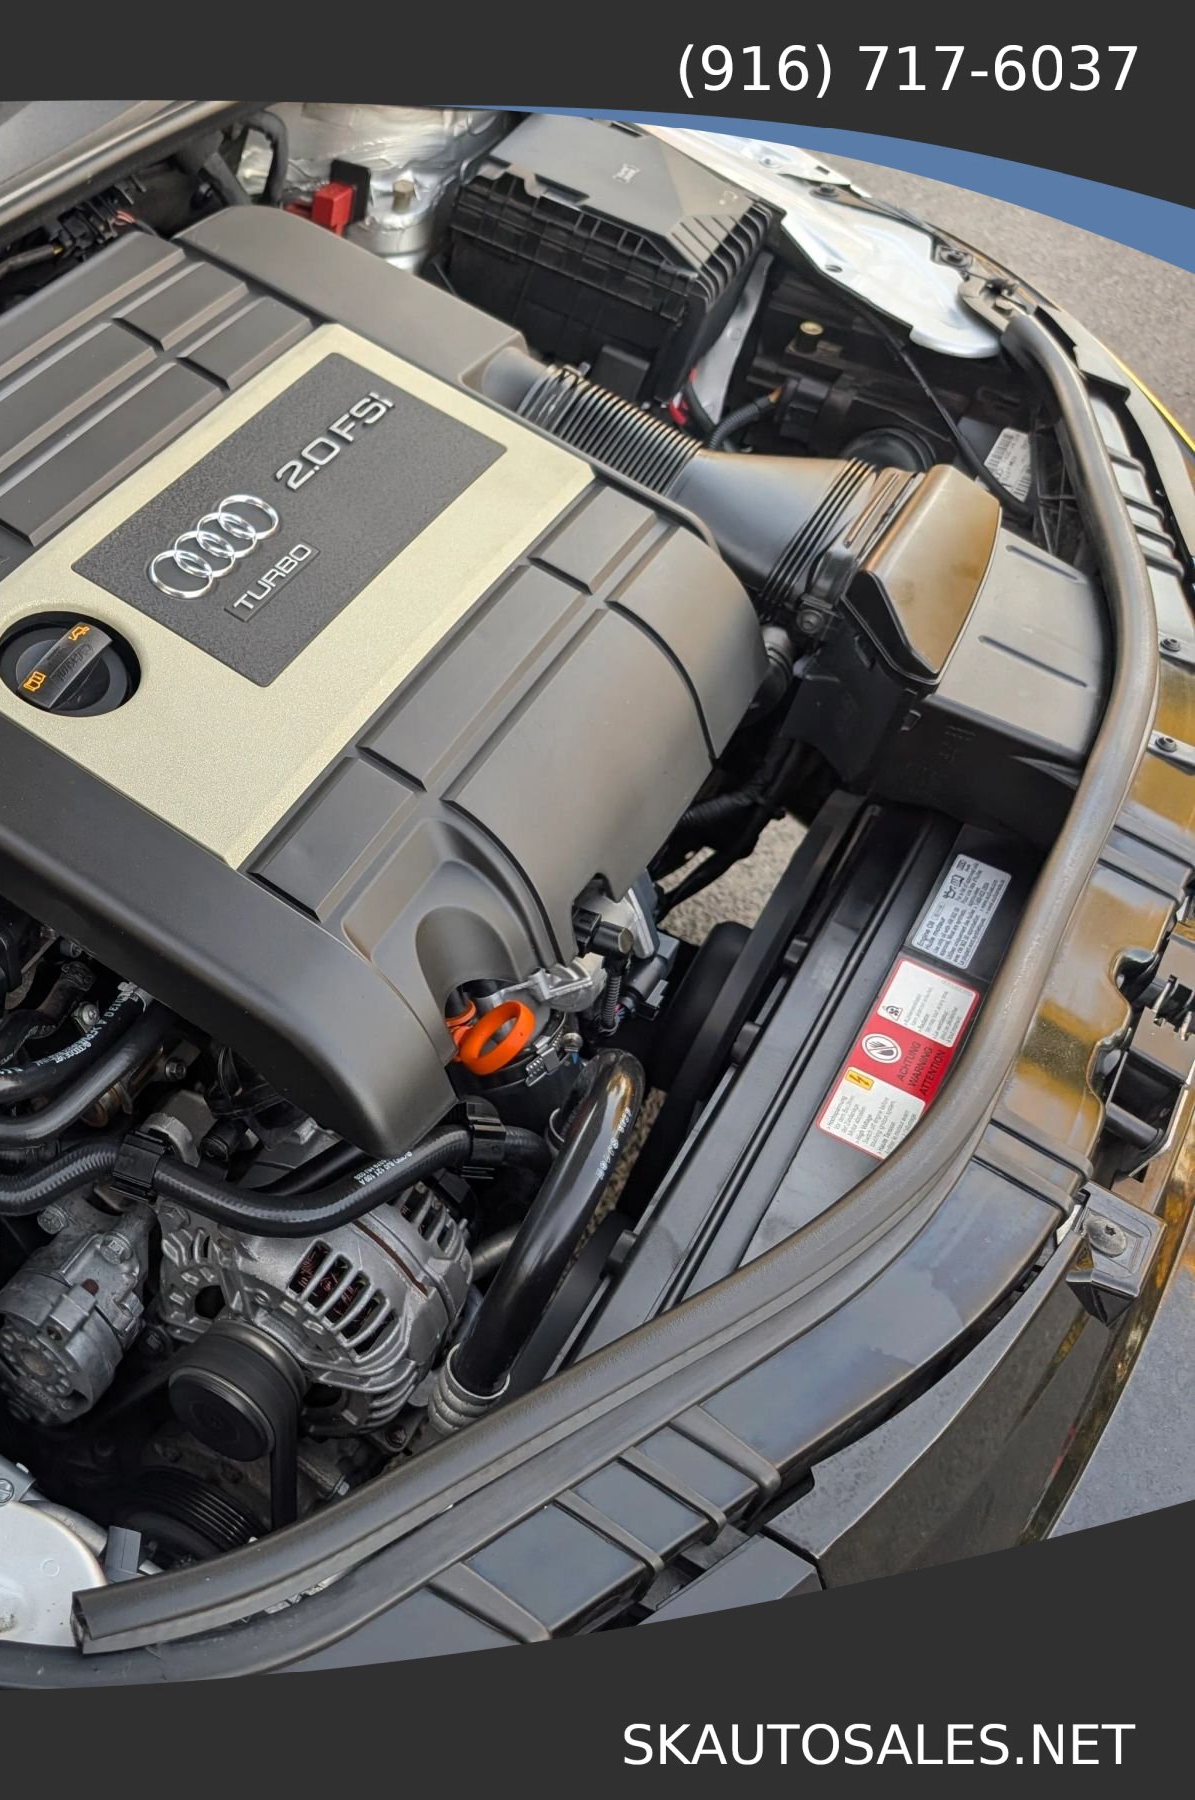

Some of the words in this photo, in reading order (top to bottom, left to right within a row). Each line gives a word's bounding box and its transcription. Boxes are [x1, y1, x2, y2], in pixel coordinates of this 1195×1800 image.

[276, 437, 341, 490] 2.0
[233, 543, 312, 609] TURBO
[917, 928, 930, 947] Engine
[926, 920, 934, 928] Oil
[895, 1041, 921, 1080] ACHTUNG
[906, 1046, 933, 1086] WARNING
[917, 1049, 946, 1095] ATTENTION
[856, 1129, 864, 1140] High
[861, 1113, 872, 1129] Voltage
